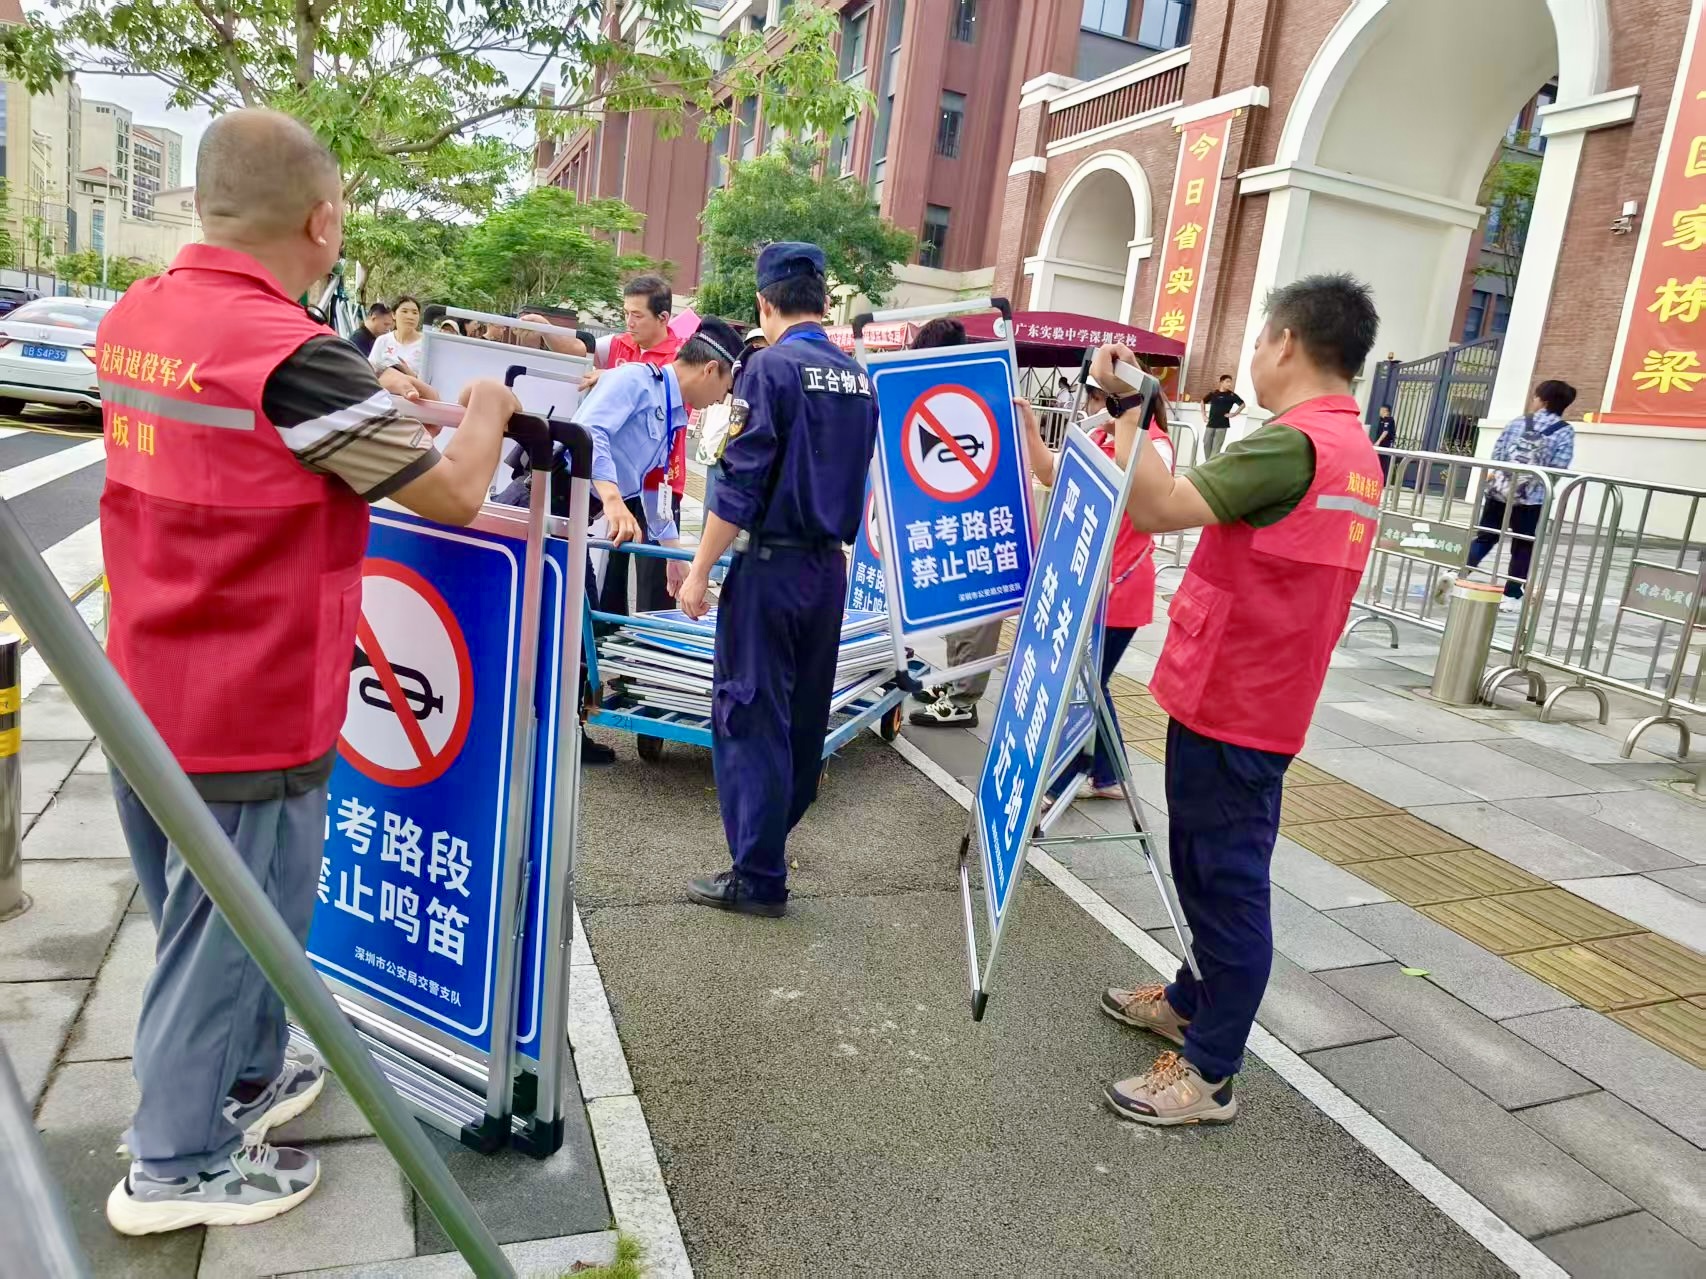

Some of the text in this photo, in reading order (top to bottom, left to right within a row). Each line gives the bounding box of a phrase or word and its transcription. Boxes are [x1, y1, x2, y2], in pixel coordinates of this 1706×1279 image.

[1157, 132, 1220, 381] 今日省实学
[1014, 322, 1137, 347] 广东实验中学深圳学校
[805, 367, 871, 396] 正合物业
[112, 412, 154, 456] 坂田
[906, 506, 1015, 553] 高考路段
[910, 541, 1019, 589] 禁止鸣笛
[325, 793, 473, 898] 考路段
[354, 945, 462, 1007] 深圳市公安局交警支队
